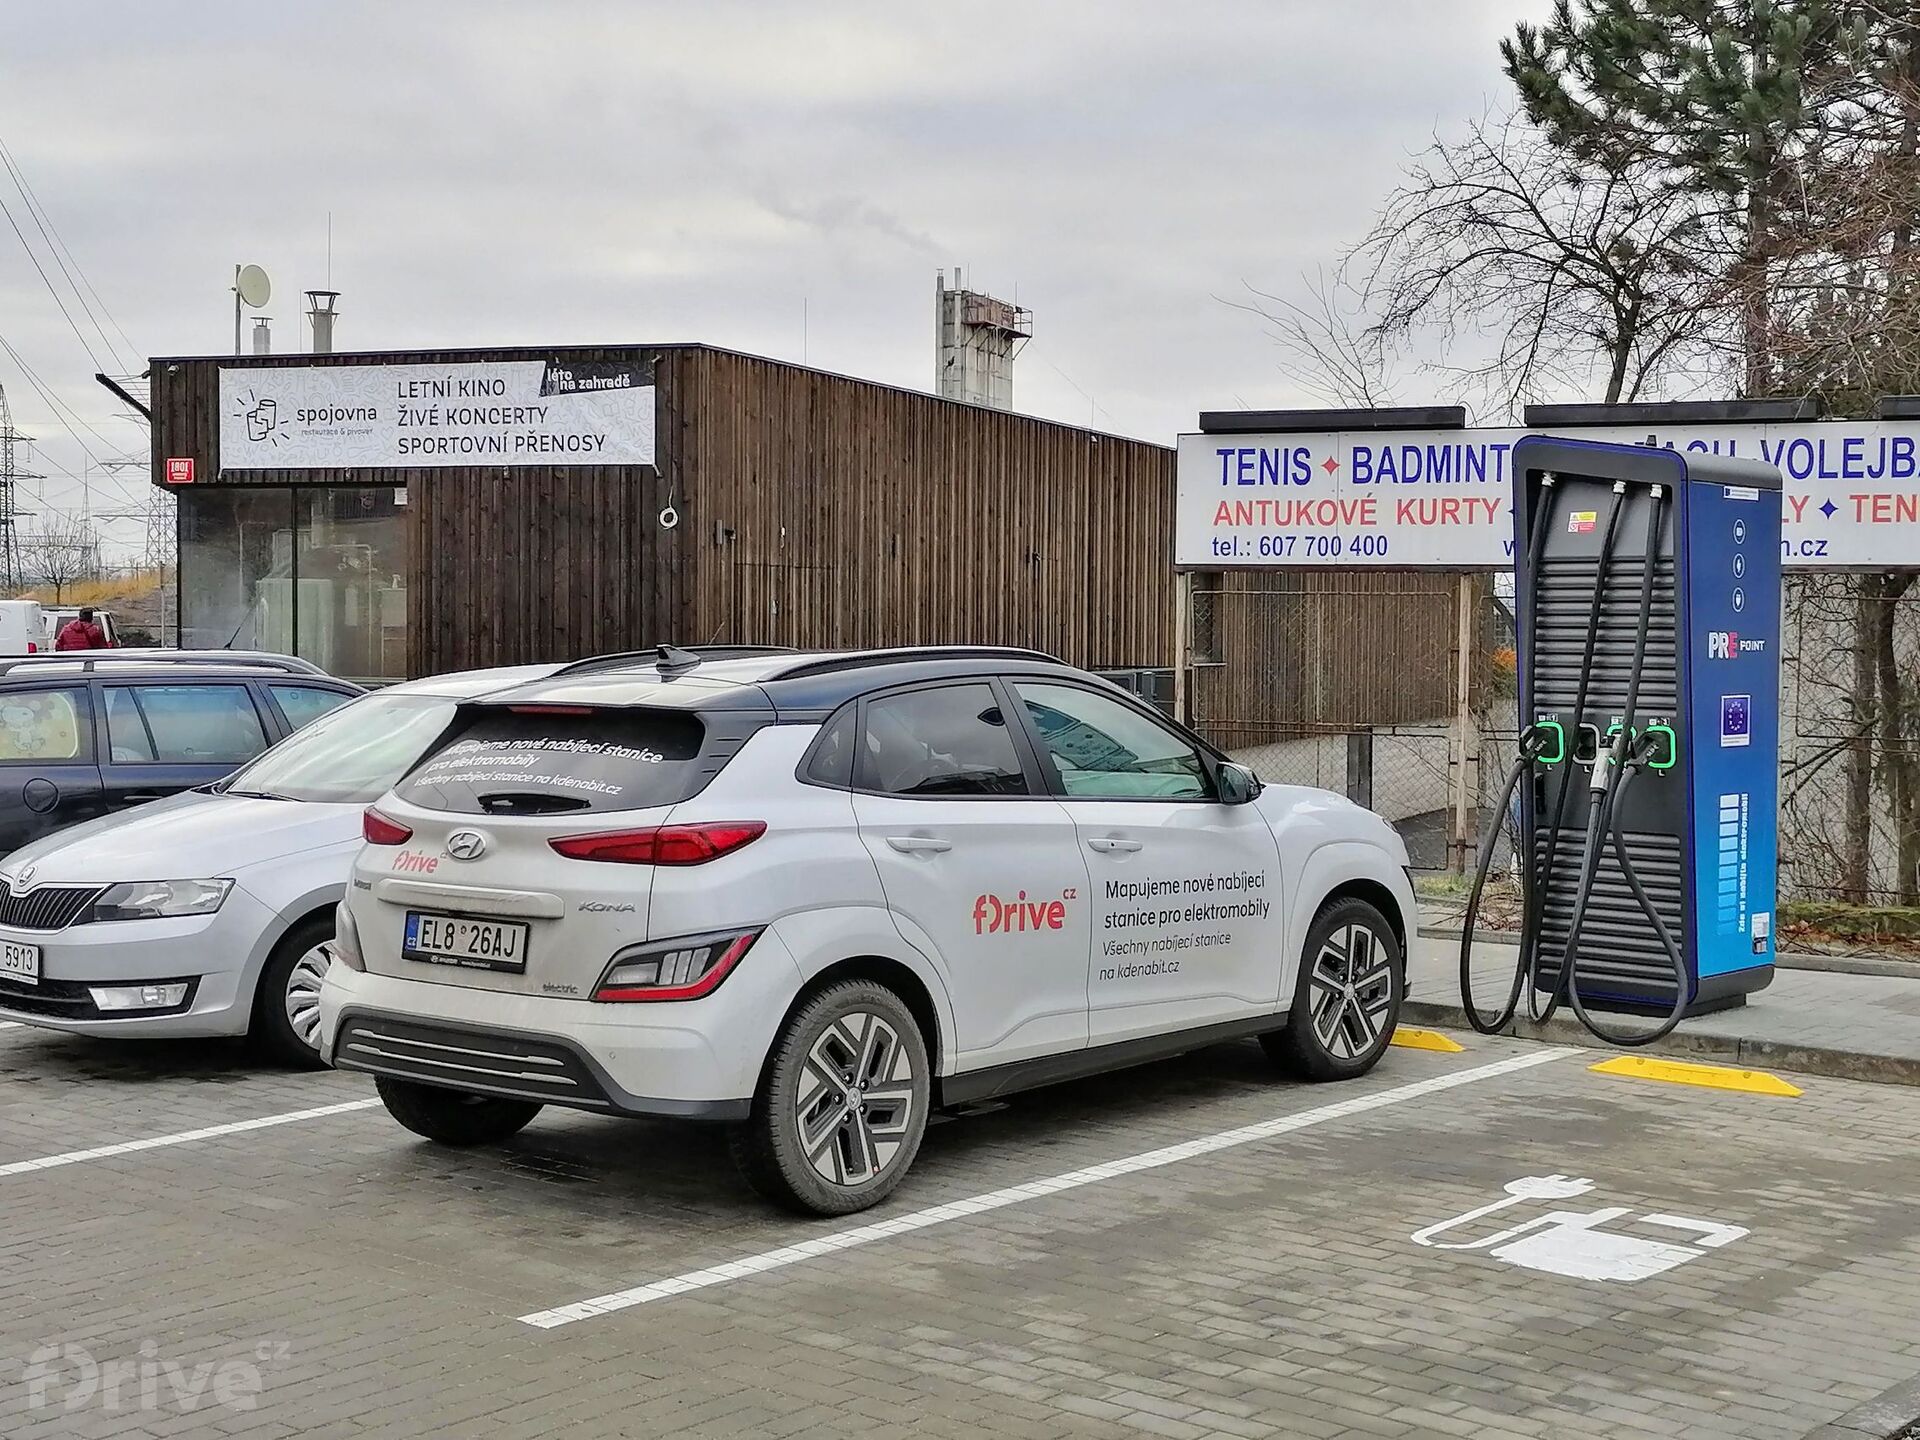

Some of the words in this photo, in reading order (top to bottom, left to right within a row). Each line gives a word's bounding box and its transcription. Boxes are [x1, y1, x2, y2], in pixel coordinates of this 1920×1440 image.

[547, 368, 572, 381] léto
[559, 379, 576, 391] na
[578, 373, 631, 390] zahradě
[398, 375, 451, 399] LETNÍ
[458, 379, 506, 397] KINO
[296, 403, 377, 426] spojovna
[397, 404, 439, 426] ŽIVÉ
[446, 406, 548, 426] KONCERTY
[398, 431, 508, 454] SPORTOVNÍ
[515, 430, 606, 453] PŘENOSY
[1216, 446, 1312, 486] TENIS
[1352, 444, 1511, 484] BADMINT
[1760, 437, 1920, 480] VOLEJB
[1213, 492, 1378, 527] ANTUKOVÉ
[1396, 497, 1503, 526] KURTY
[1849, 494, 1918, 523] TEN
[1212, 535, 1251, 557] tel.:
[1259, 535, 1297, 557] 607
[1305, 535, 1342, 557] 700
[1349, 534, 1389, 557] 400
[1708, 631, 1738, 659] PRE
[1740, 640, 1765, 651] POINT
[444, 739, 509, 757] Mapujeme
[505, 738, 548, 750] nové
[547, 738, 605, 756] nabíjecí
[600, 743, 664, 764] stanice
[425, 760, 449, 774] pro
[449, 755, 541, 769] elektromobily
[451, 771, 492, 784] nabíjecí
[490, 770, 534, 784] stanice
[533, 774, 552, 785] na
[550, 773, 624, 795] kdenabit.cz
[1105, 878, 1181, 901] Mapujeme
[1183, 873, 1214, 894] nové
[1217, 869, 1266, 892] nabíjecí
[578, 901, 636, 912] KONA
[1104, 907, 1156, 929] stanice
[1158, 908, 1182, 928] pro
[1184, 899, 1271, 921] elektromobily
[421, 920, 455, 950] EL8
[468, 925, 517, 957] 26AJ
[1102, 937, 1149, 957] Všechny
[1151, 933, 1193, 953] nabíjecí
[1194, 931, 1232, 949] stanice
[5, 945, 33, 971] 5913
[1099, 966, 1115, 981] na
[1117, 959, 1180, 980] kdenabit.cz
[543, 982, 579, 994] electric
